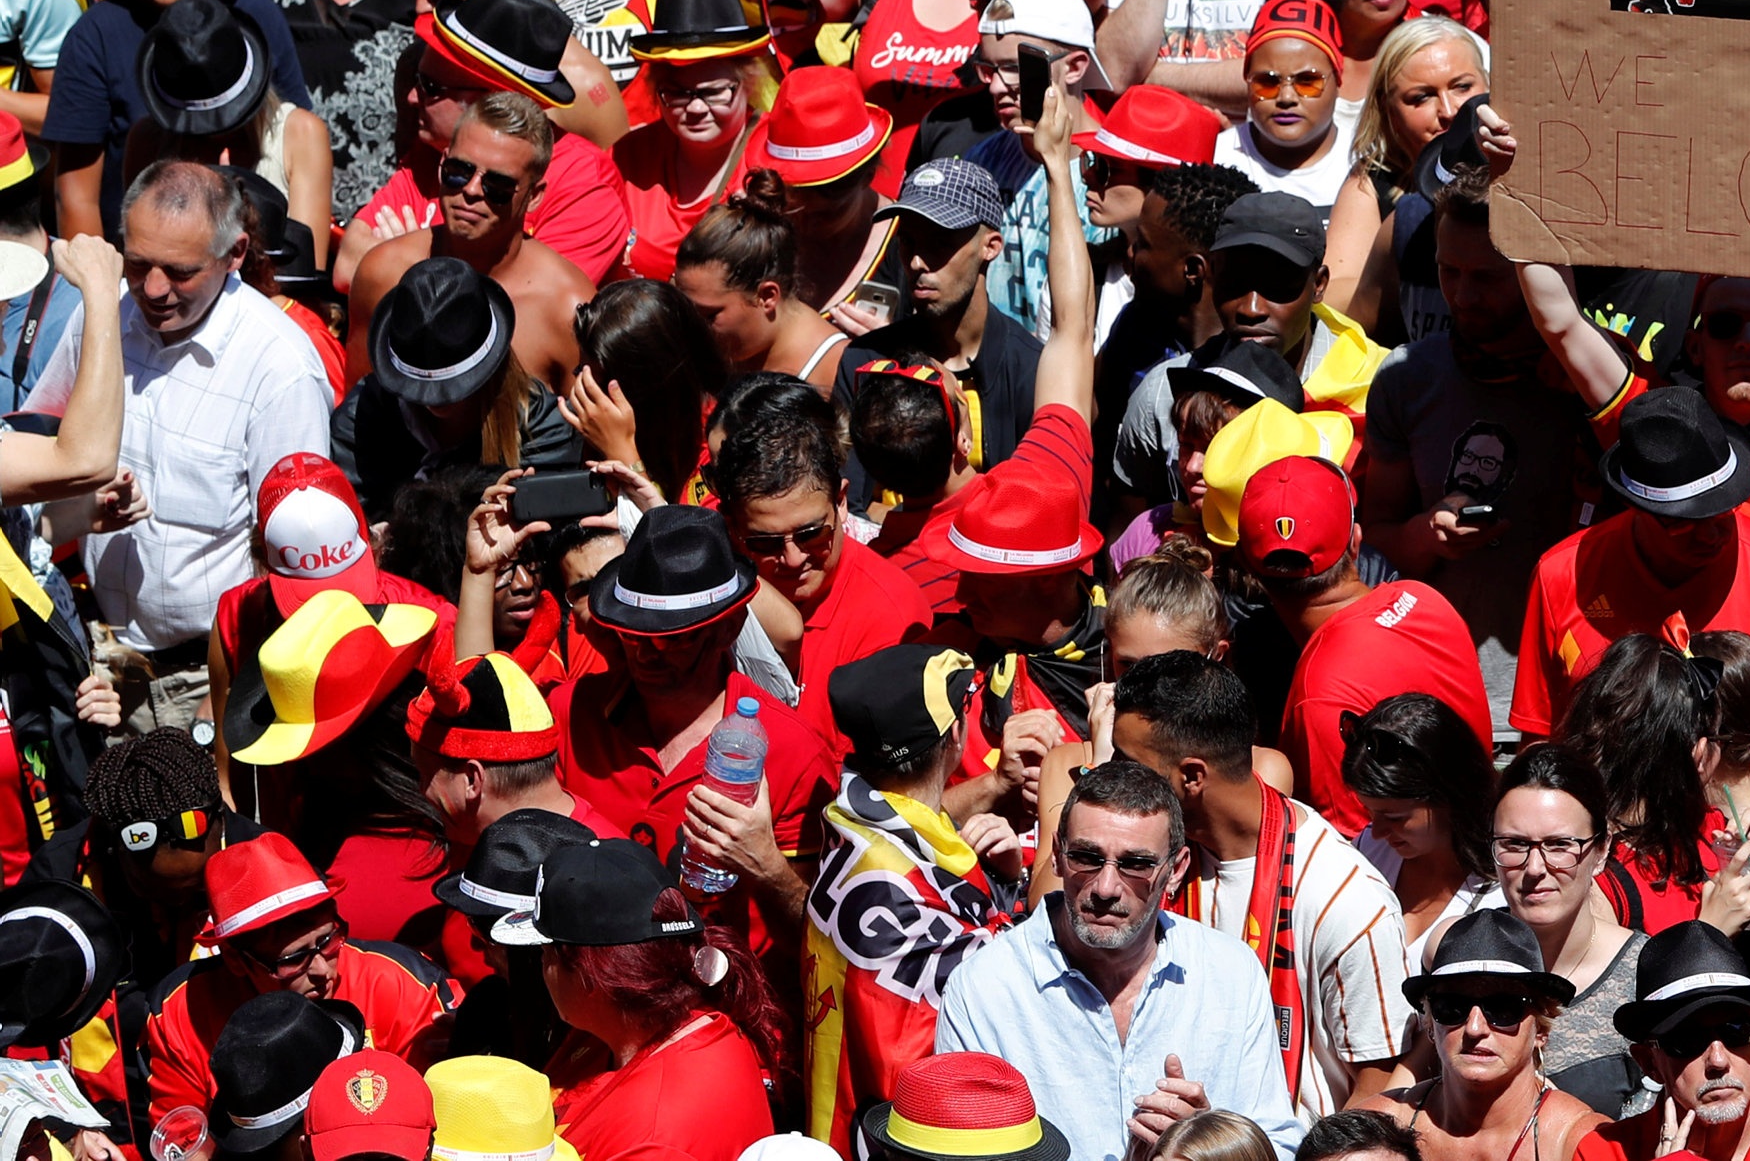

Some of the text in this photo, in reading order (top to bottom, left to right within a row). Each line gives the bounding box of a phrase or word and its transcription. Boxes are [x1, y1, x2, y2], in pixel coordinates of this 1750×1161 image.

[1549, 48, 1668, 109] WE
[279, 540, 355, 571] Coke
[1374, 591, 1419, 629] BELGIUM
[1281, 1009, 1290, 1047] BELGIQUE
